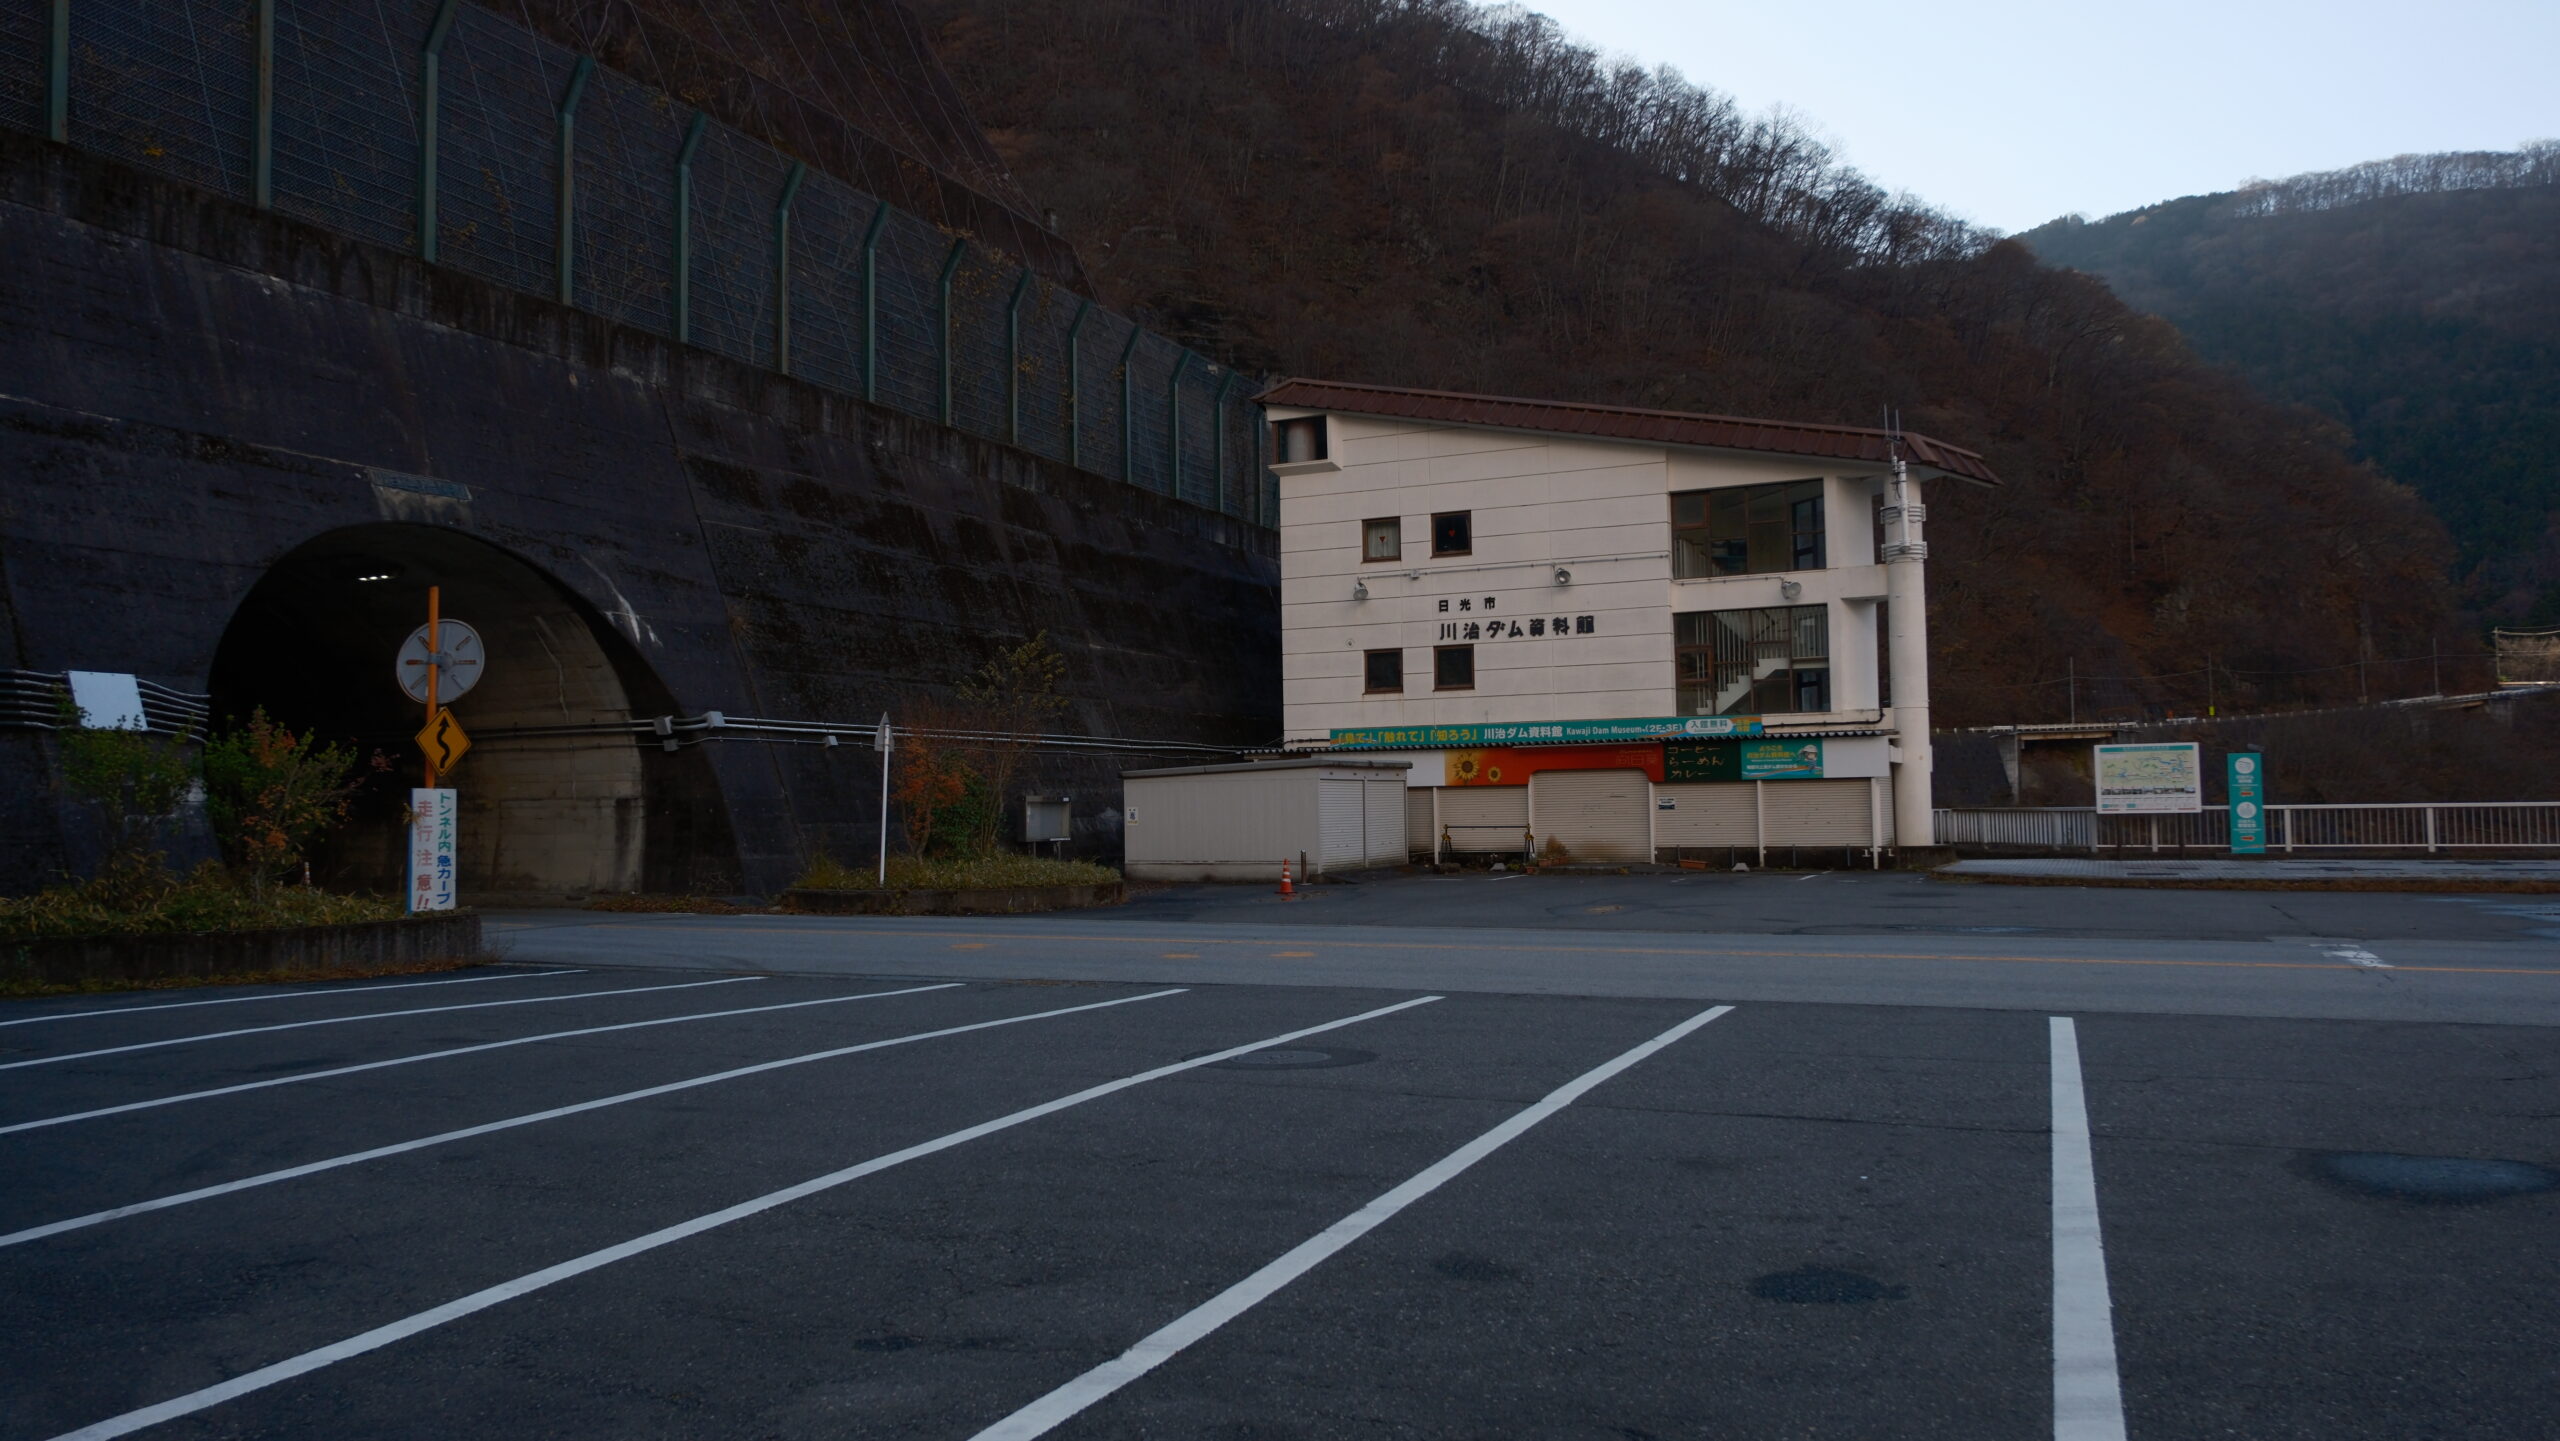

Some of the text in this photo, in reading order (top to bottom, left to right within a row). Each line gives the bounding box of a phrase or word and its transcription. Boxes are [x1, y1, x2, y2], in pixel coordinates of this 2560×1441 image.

[1438, 597, 1496, 613] 日光市
[1439, 615, 1596, 641] 川治ダム資料館
[1690, 719, 1728, 729] 入館無料
[1483, 725, 1563, 740] 川治ダム資料館
[1566, 725, 1591, 736] Kawaji
[1592, 725, 1609, 735] Dam
[1610, 724, 1642, 735] Museum
[1667, 745, 1721, 755] コーヒー
[1668, 755, 1726, 767] らーめん
[1670, 768, 1713, 779] カレー
